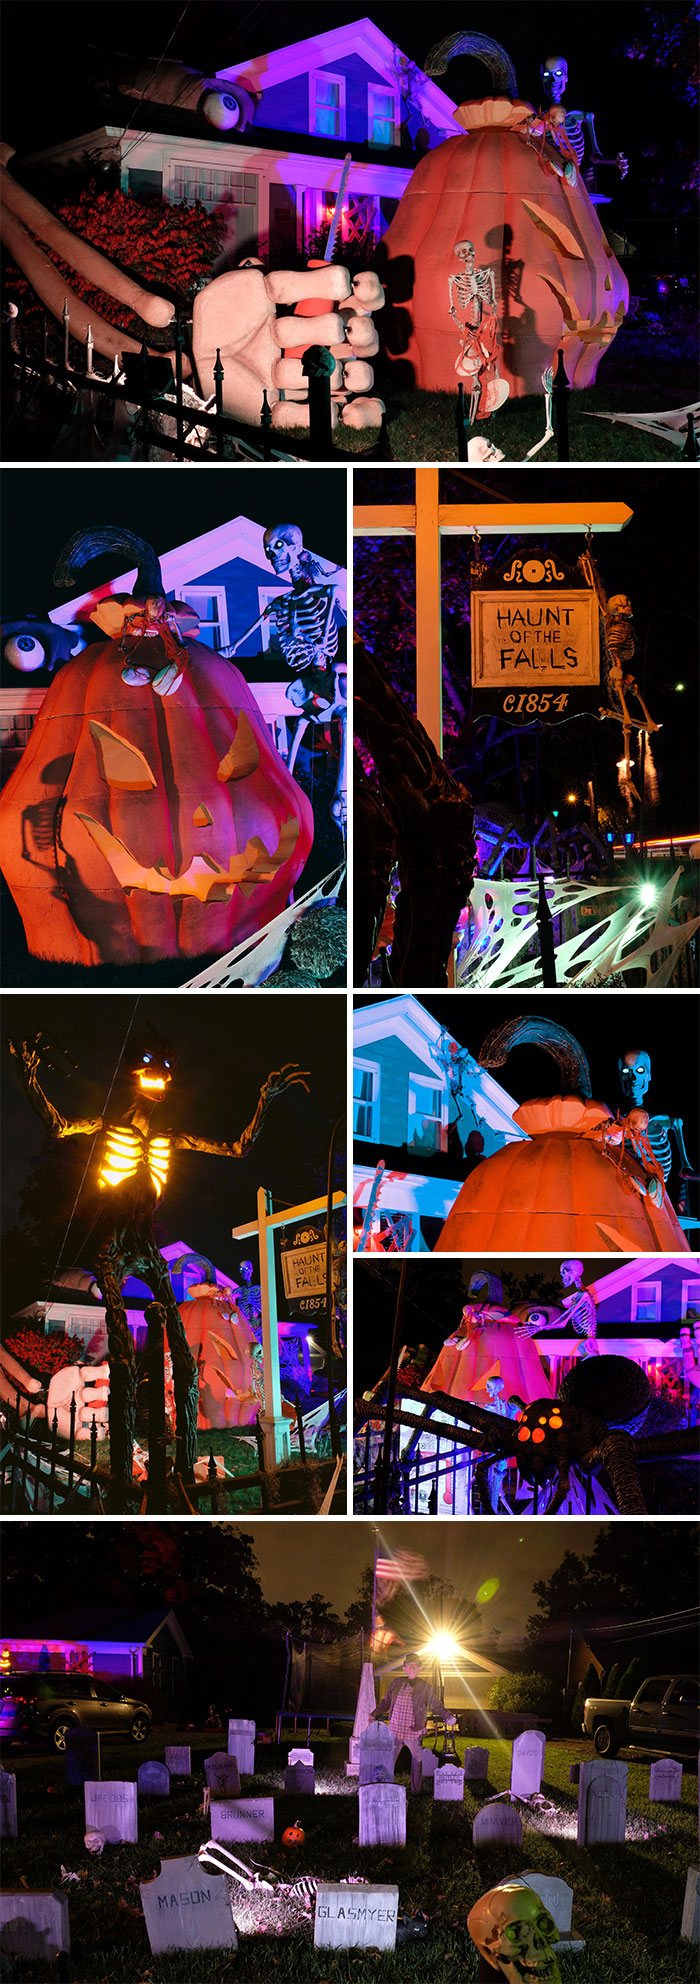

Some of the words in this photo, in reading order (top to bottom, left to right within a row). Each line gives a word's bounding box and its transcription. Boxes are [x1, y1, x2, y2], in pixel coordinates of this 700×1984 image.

[497, 606, 574, 629] HAUNT
[510, 630, 530, 643] OF
[535, 630, 561, 643] THE
[500, 647, 578, 670] FALLS
[292, 1252, 325, 1268] HAUNT
[298, 1267, 308, 1275] OF
[309, 1265, 321, 1273] THE
[220, 1809, 265, 1820] BRUNNER
[157, 1888, 212, 1910] MASON
[317, 1904, 395, 1924] GLASMYER
